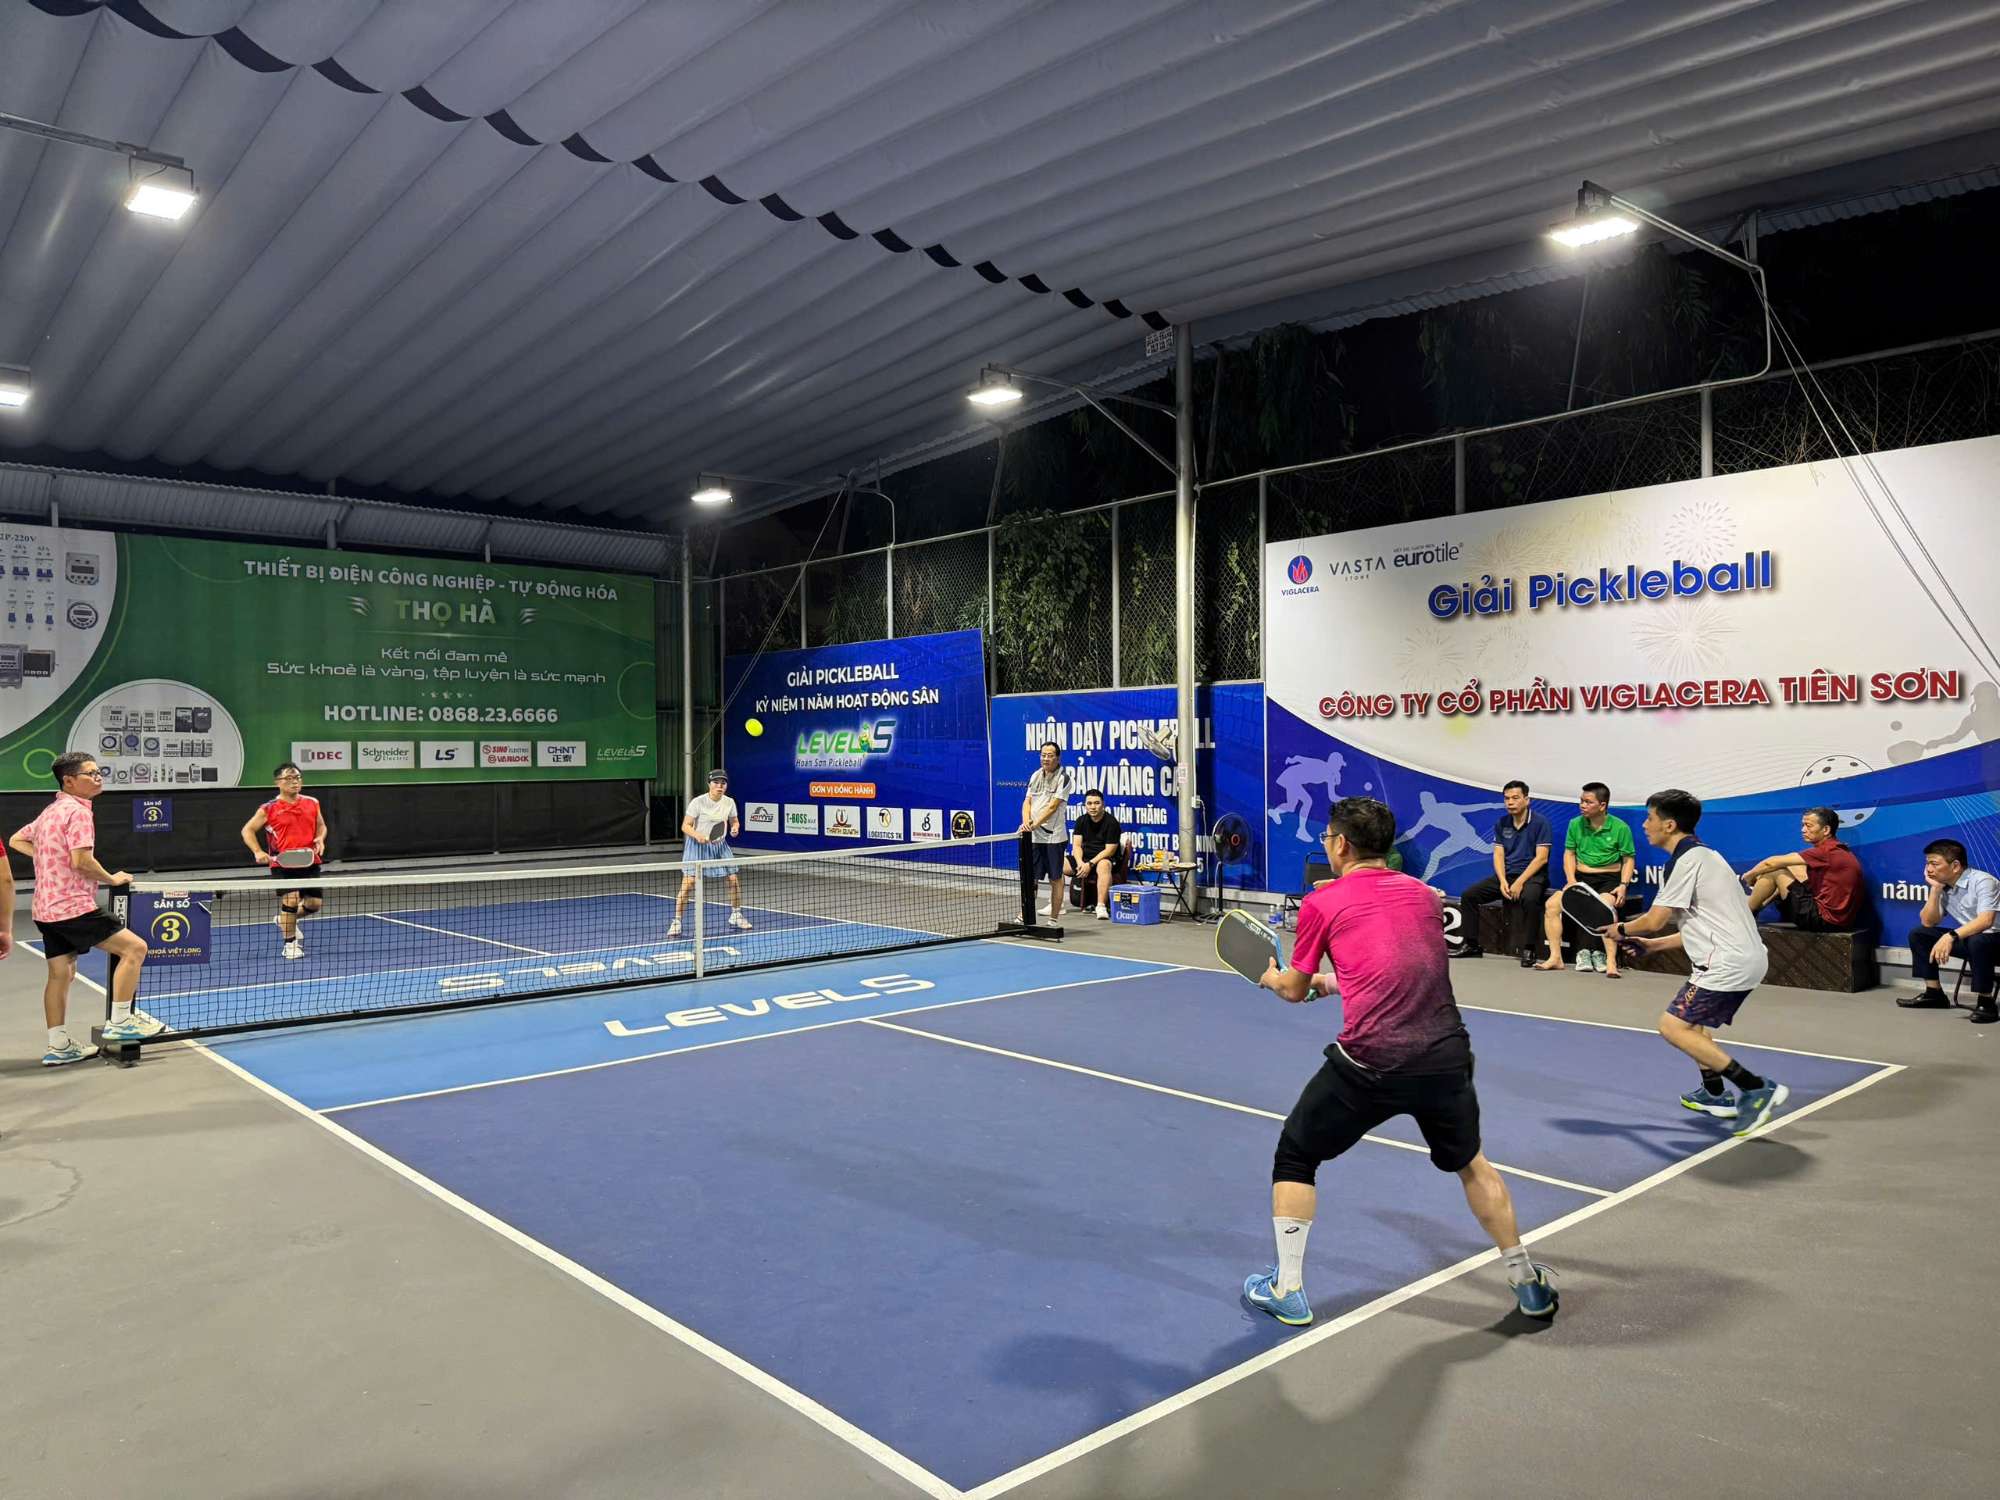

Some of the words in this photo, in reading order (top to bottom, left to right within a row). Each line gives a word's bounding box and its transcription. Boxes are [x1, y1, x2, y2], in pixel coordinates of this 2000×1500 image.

[244, 556, 301, 577] THIẾT
[306, 565, 324, 583] BỊ
[329, 564, 373, 585] ĐIỆN
[378, 567, 428, 587] CÔNG
[432, 574, 495, 594] NGHIỆP
[509, 580, 532, 597] TỰ
[536, 580, 582, 599] ĐỘNG
[586, 584, 618, 601] HÓA
[1428, 574, 1513, 618] Giải
[1528, 549, 1772, 609] Pickleball
[1281, 585, 1320, 596] VIGLACERA
[395, 600, 451, 627] THỌ
[460, 599, 496, 624] HÀ
[381, 647, 410, 660] Kết
[414, 648, 441, 661] nối
[445, 650, 480, 663] đam
[484, 651, 508, 663] mê
[267, 662, 305, 675] Sức
[361, 664, 376, 677] là
[380, 666, 429, 681] vàng,
[433, 667, 461, 681] tập
[464, 668, 510, 682] luyện
[514, 669, 527, 681] là
[531, 670, 561, 682] sức
[564, 673, 606, 685] mạnh
[787, 666, 813, 688] GIẢI
[816, 662, 900, 686] PICKLEBALL
[755, 695, 770, 713] KỶ
[771, 694, 798, 715] NIỆM
[800, 697, 806, 711] 1
[807, 692, 833, 710] NĂM
[836, 692, 869, 712] HOẠT
[871, 688, 909, 710] ĐỘNG
[911, 686, 940, 705] SÂN
[1318, 690, 1395, 719] CÔNG
[1400, 692, 1432, 715] TY
[1437, 676, 1482, 714] CỔ
[1489, 676, 1570, 712] PHẦN
[1579, 677, 1770, 710] VIGLACERA
[1778, 667, 1860, 703] TIÊN
[1869, 667, 1960, 701] SƠN
[323, 705, 425, 722] HOTLINE:
[428, 706, 559, 723] 0868.23.6666
[1072, 720, 1105, 757] DẠY
[311, 751, 343, 760] IDEC
[362, 748, 409, 762] Schneider
[435, 749, 456, 761] LS
[148, 809, 158, 822] 3
[1135, 804, 1168, 825] THĂNG
[1882, 880, 1929, 901] năm
[153, 898, 174, 909] SÂN
[176, 897, 191, 909] SỐ
[161, 918, 180, 942] 3
